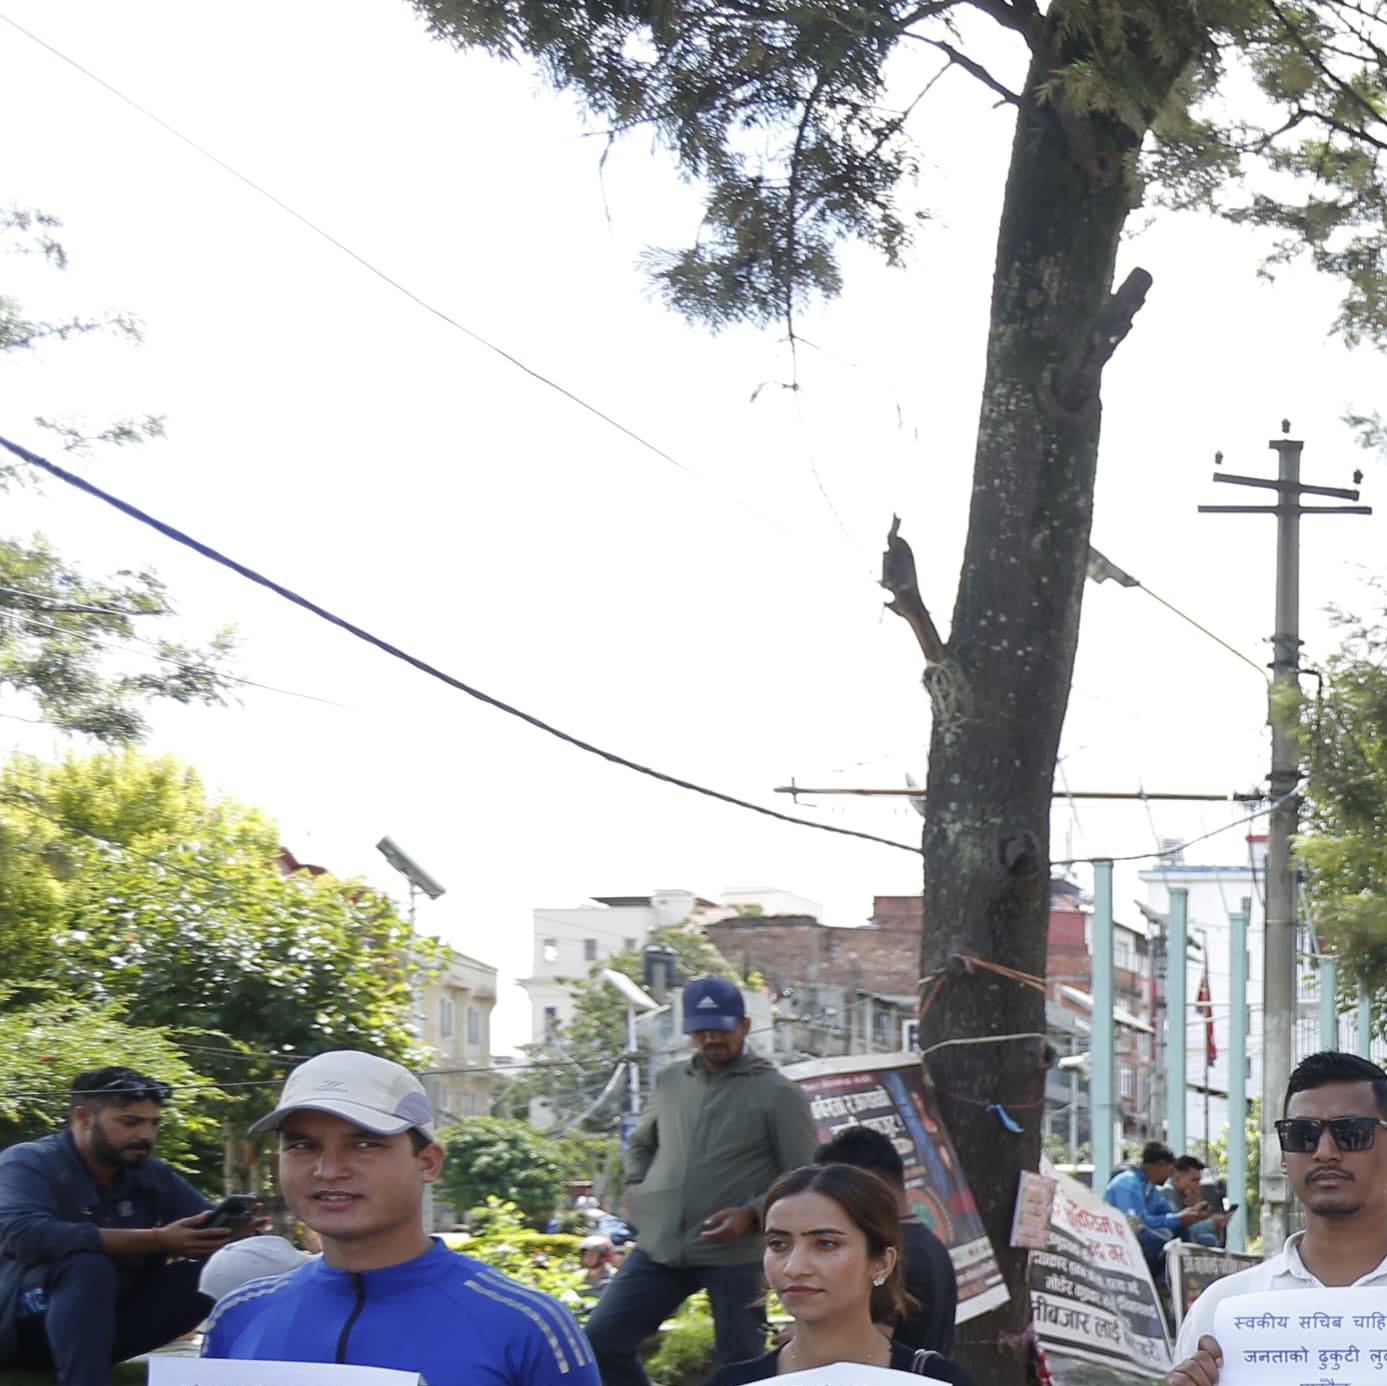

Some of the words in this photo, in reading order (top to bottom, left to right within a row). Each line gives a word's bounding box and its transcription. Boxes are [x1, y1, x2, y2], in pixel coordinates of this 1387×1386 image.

[1234, 1312, 1290, 1330] स्वकीय
[1299, 1312, 1344, 1329] सचिब
[1243, 1346, 1309, 1363] जनताको
[1318, 1345, 1360, 1371] ढुकुटी
